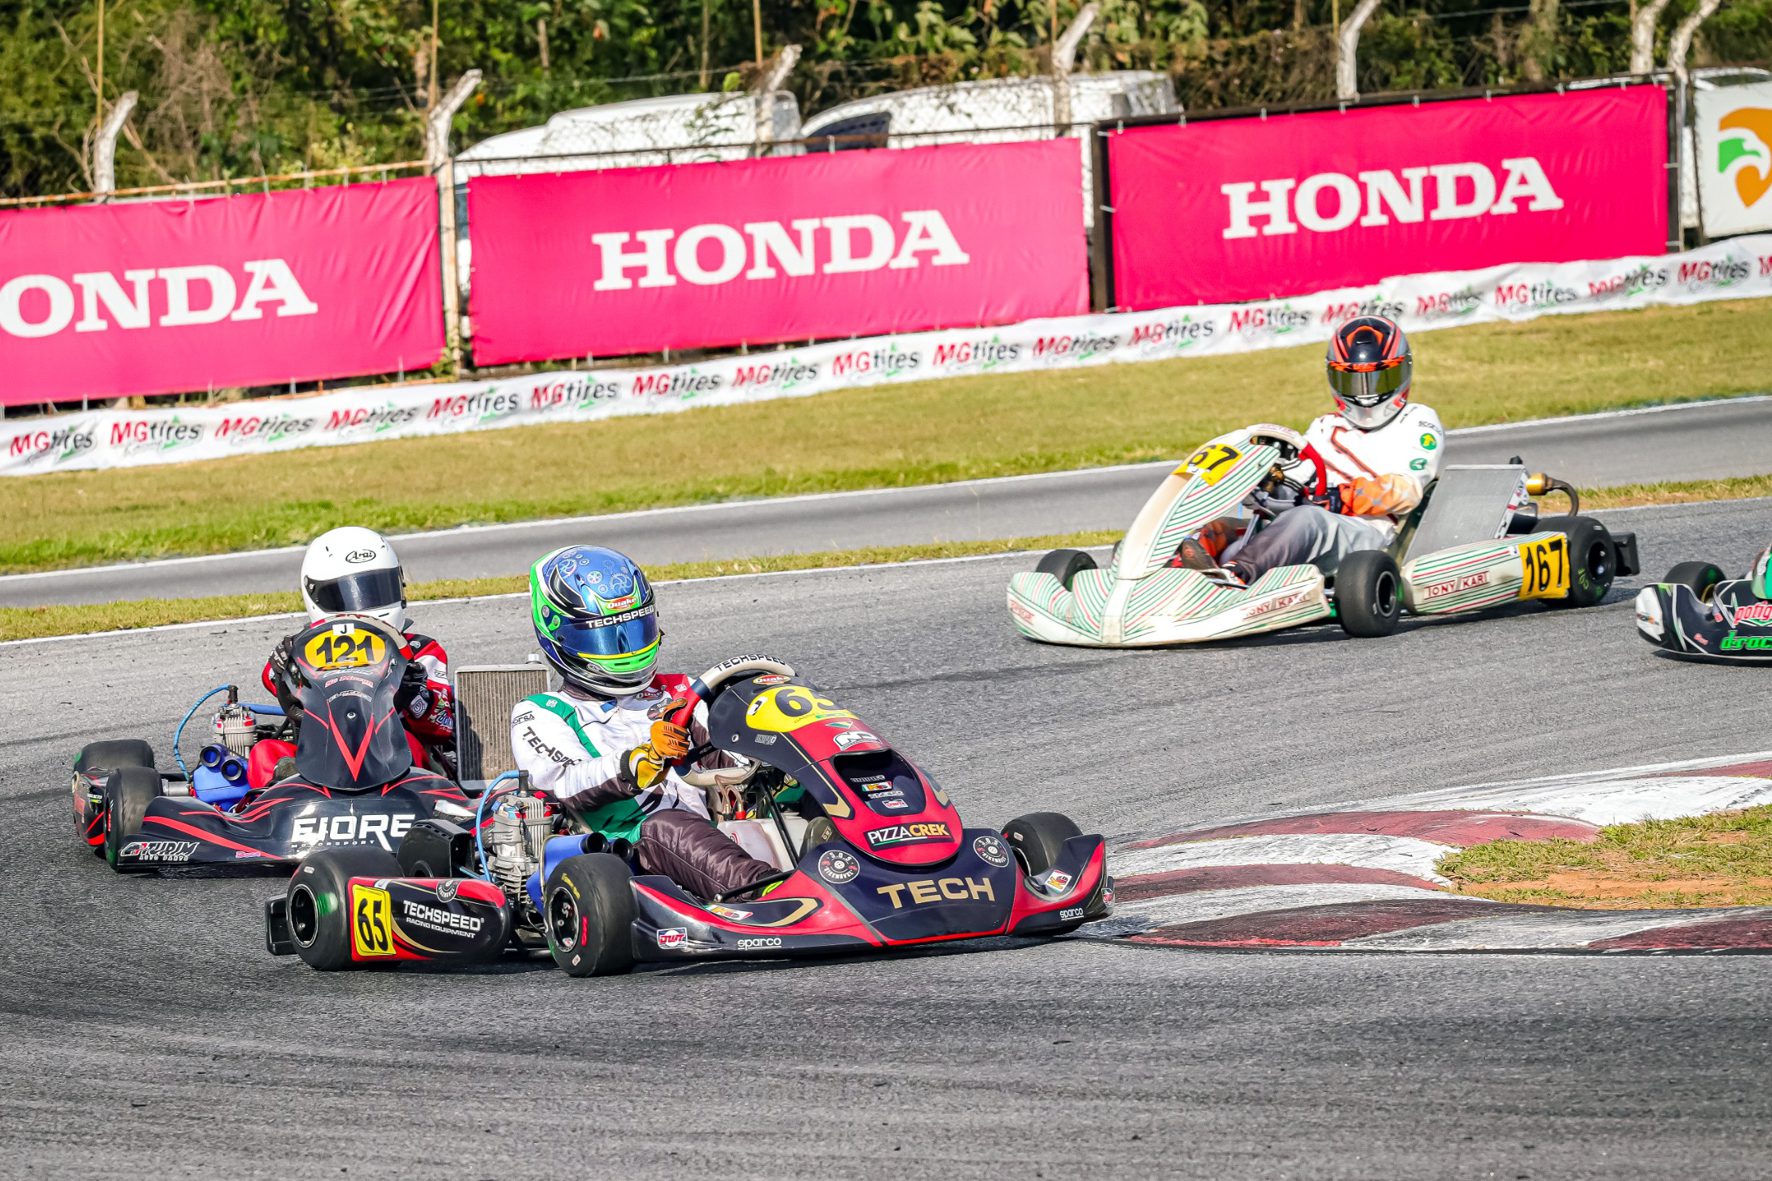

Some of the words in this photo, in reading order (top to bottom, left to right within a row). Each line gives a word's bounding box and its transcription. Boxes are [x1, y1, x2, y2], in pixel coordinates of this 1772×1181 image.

[1220, 156, 1565, 240] HONDA
[592, 210, 970, 291] HONDA
[1677, 258, 1749, 284] MGtires
[1495, 283, 1577, 305] MGtires
[1129, 317, 1214, 347] MGtires
[1228, 307, 1311, 332] MGtires
[933, 339, 1020, 366] MGtires
[1032, 331, 1120, 357] MGtires
[731, 361, 819, 388] MGtires
[832, 348, 920, 376] MGtires
[531, 381, 618, 410] MGtires
[632, 370, 721, 396] MGtires
[427, 392, 519, 420] MGtires
[110, 420, 202, 446] MGtires
[215, 414, 315, 438] MGtires
[10, 430, 94, 457] MGtires
[346, 549, 375, 563] Arai
[1526, 538, 1563, 593] 167
[340, 624, 348, 634] J
[586, 605, 655, 629] TECHSPEED
[316, 635, 374, 667] 121
[714, 653, 786, 673] TECHSPEED
[290, 839, 375, 849] MOORSPORT
[877, 877, 996, 909] TECH
[356, 897, 389, 951] 65
[403, 900, 481, 932] TECHSPEED
[1059, 907, 1084, 920] sparco
[406, 916, 431, 928] RACING
[431, 924, 476, 939] EQUIPMENT
[737, 937, 782, 950] sparco
